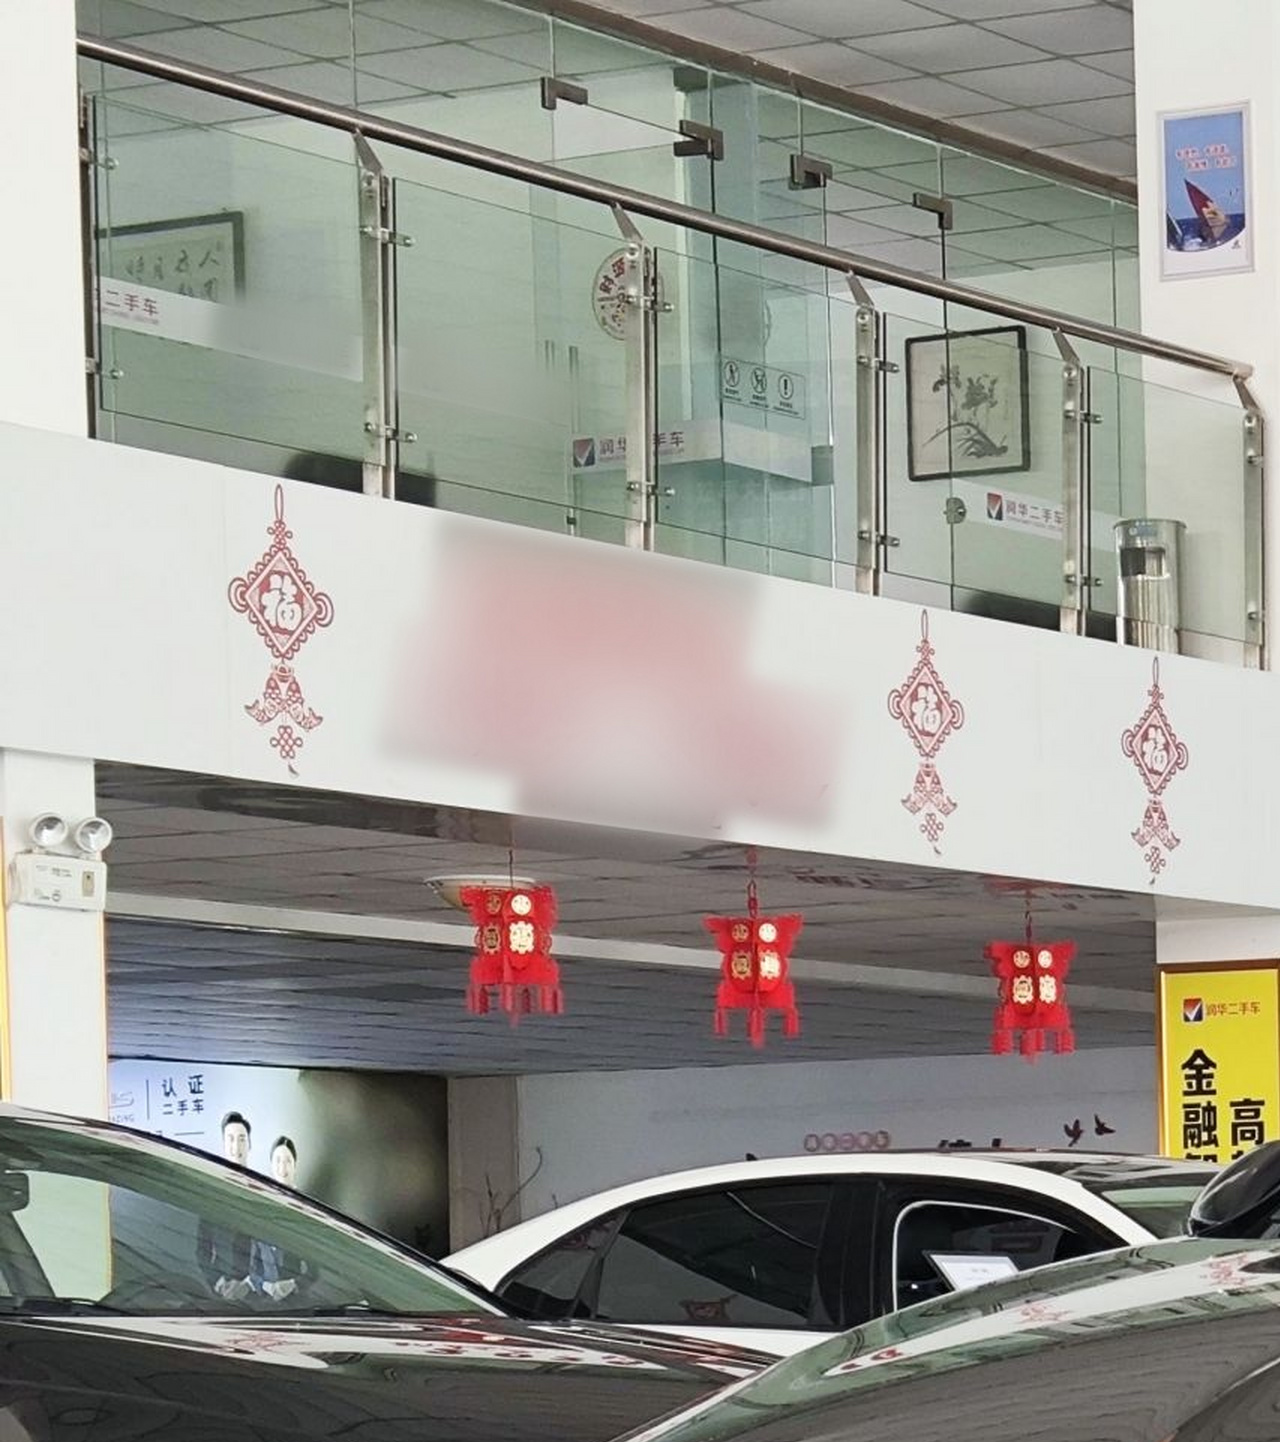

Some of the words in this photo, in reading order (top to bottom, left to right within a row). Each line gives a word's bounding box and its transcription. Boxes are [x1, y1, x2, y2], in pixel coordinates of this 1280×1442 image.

[105, 289, 159, 316] 二手车
[1206, 1001, 1261, 1016] 润华二手车
[162, 1074, 204, 1097] 认证
[162, 1098, 204, 1116] 二手车
[1229, 1097, 1265, 1160] 高
